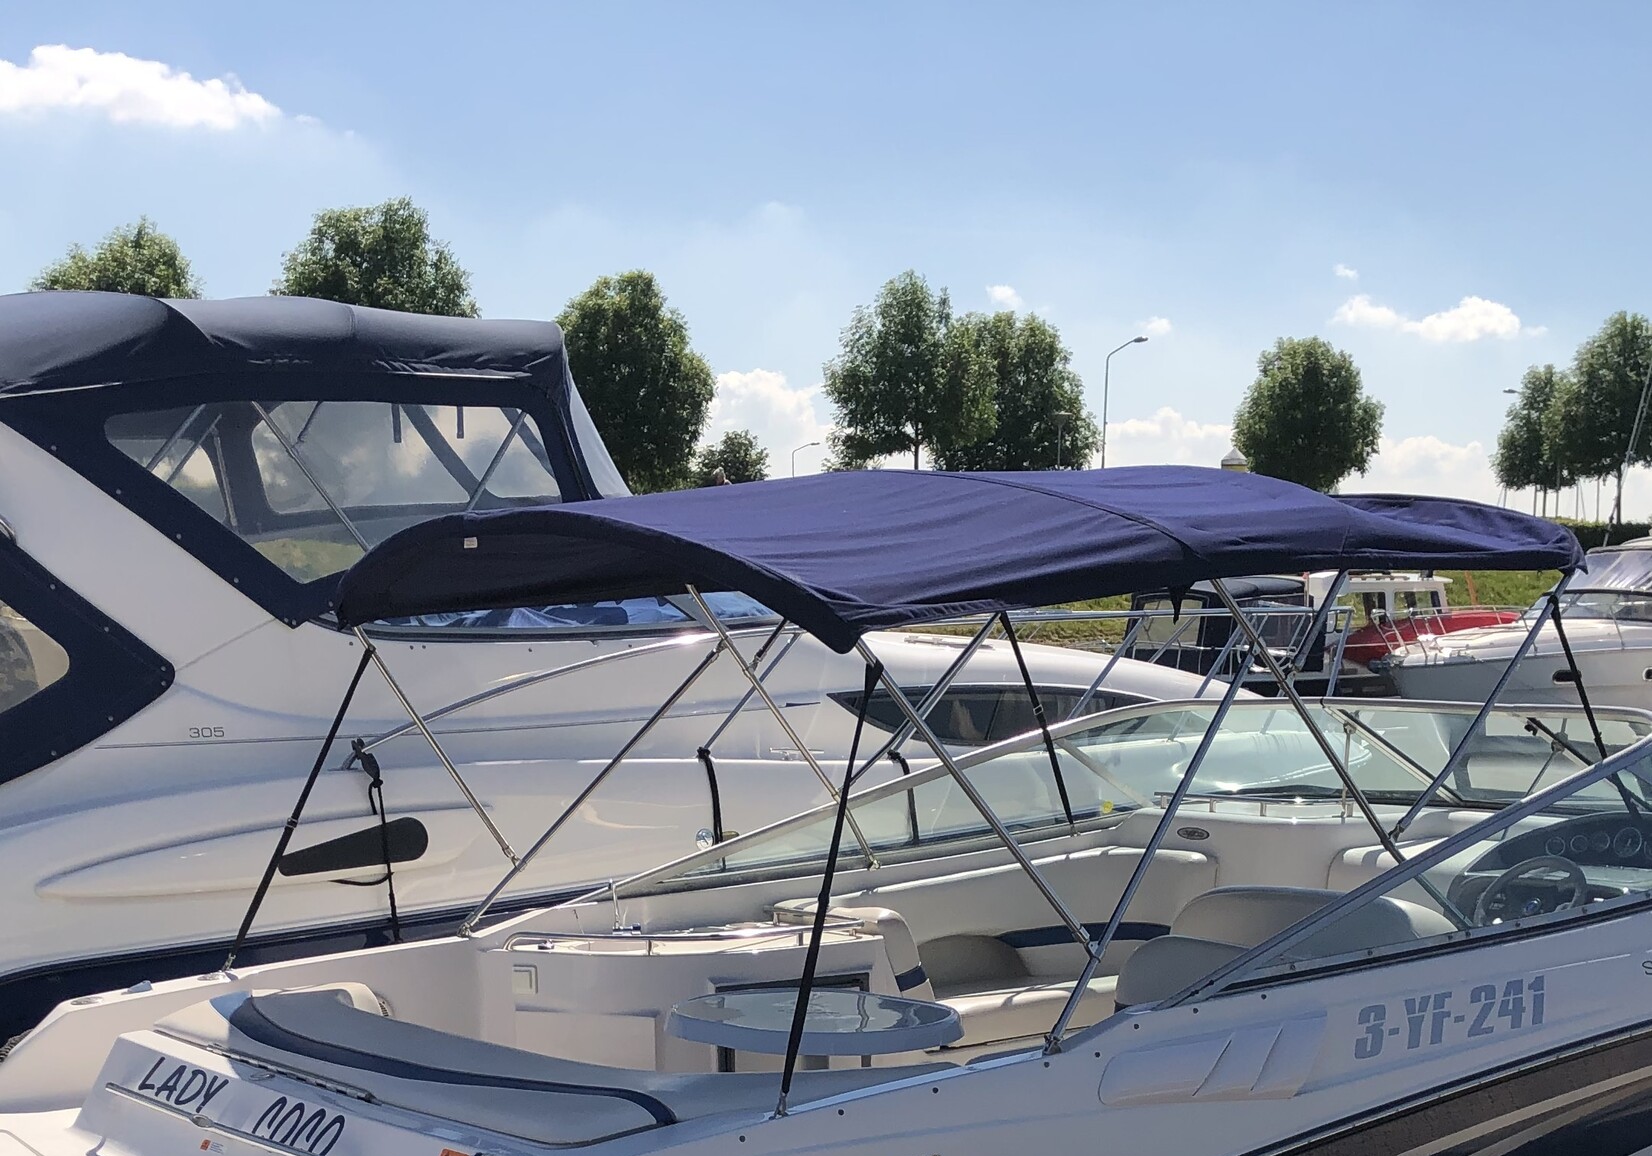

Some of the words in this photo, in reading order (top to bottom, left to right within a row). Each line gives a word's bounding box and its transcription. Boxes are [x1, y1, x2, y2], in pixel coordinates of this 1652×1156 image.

[189, 726, 225, 739] 305
[1354, 975, 1545, 1060] 3-YF-241
[138, 1056, 230, 1113] LADY
